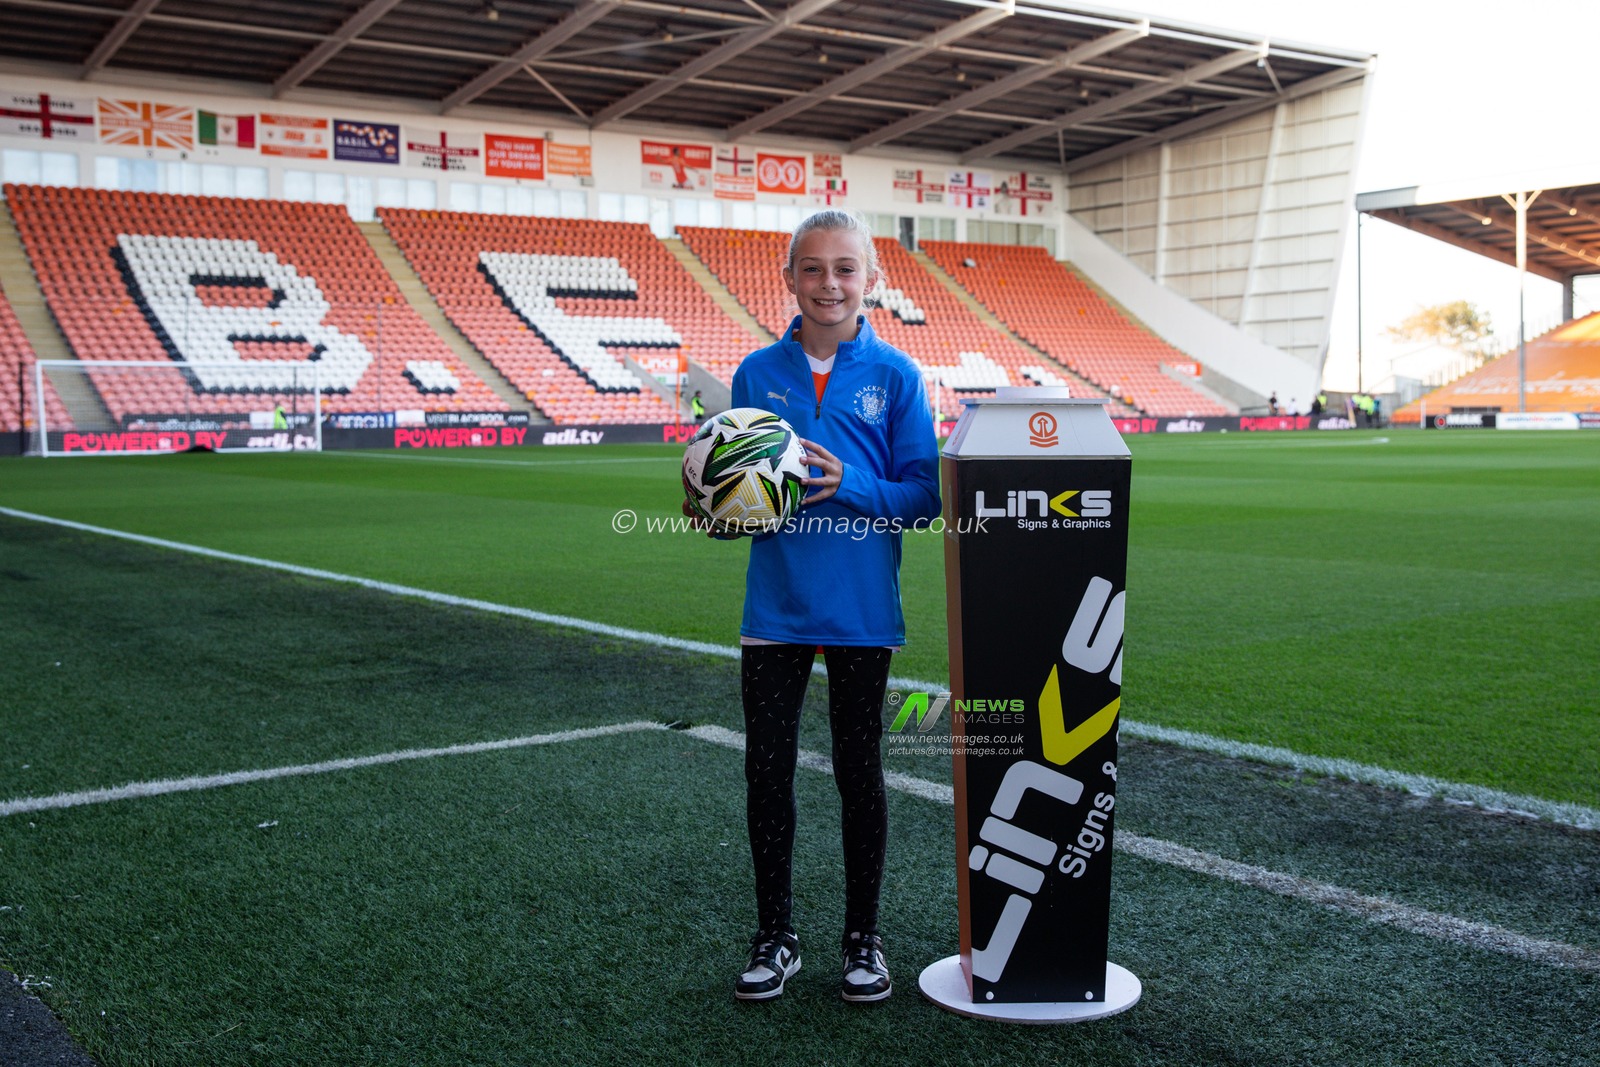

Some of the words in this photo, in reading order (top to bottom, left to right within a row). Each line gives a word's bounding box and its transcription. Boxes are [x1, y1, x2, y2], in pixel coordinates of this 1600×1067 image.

[493, 140, 512, 150] YOU
[488, 149, 506, 159] OUR
[500, 160, 523, 170] YOUR
[854, 385, 888, 399] BLACKPO
[63, 431, 190, 453] POWERED
[394, 428, 497, 448] POWERED
[501, 428, 527, 446] BY
[1017, 518, 1048, 531] Signs
[1052, 518, 1060, 529] &
[1062, 518, 1111, 531] Graphics
[1058, 791, 1116, 878] Signs
